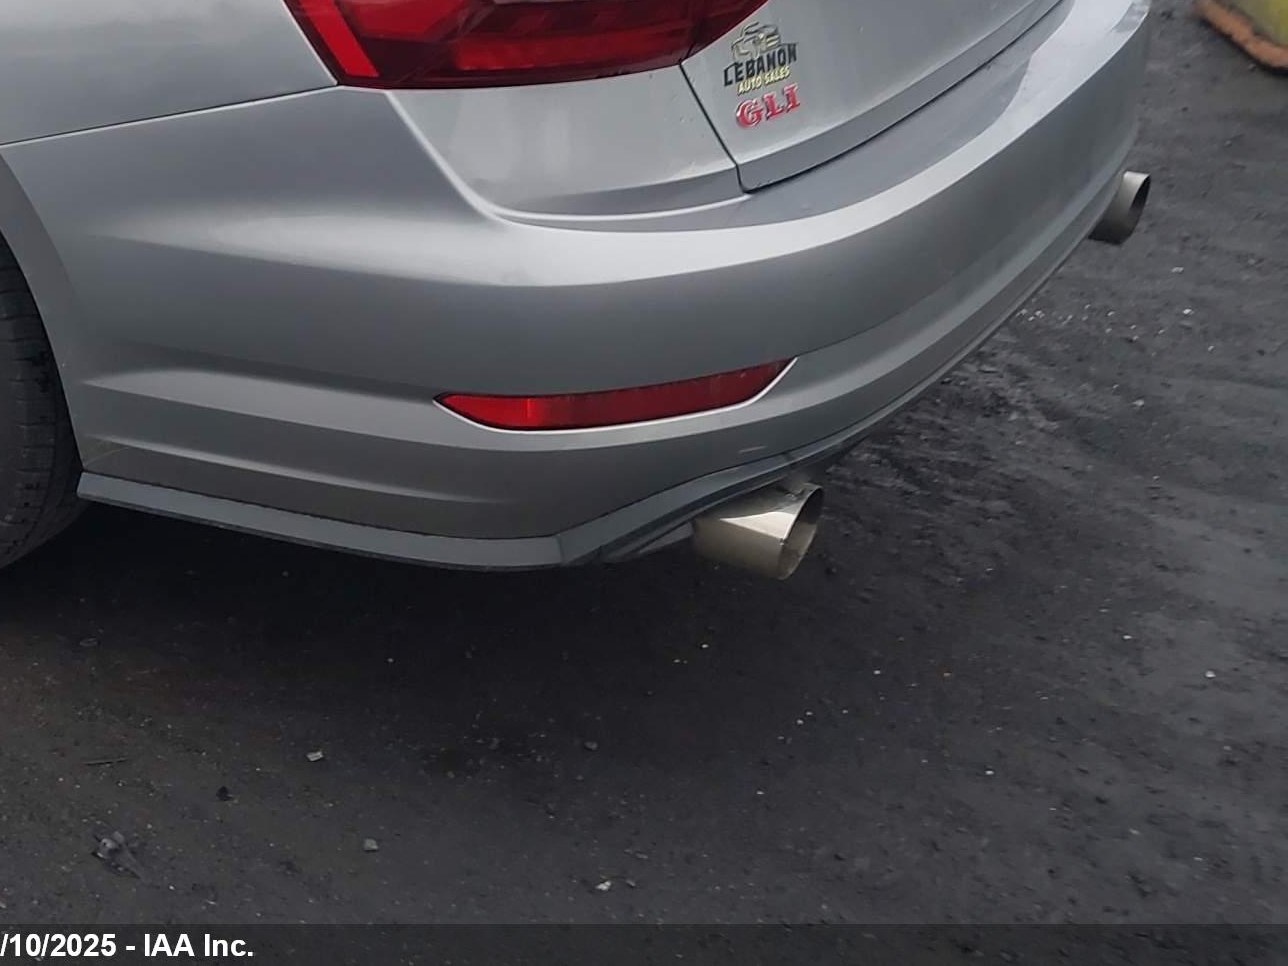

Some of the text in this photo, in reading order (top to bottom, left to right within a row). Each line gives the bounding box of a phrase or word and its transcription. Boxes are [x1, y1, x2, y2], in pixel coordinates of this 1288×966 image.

[723, 42, 798, 87] LEBANON
[737, 65, 791, 96] AUTO SALES
[736, 83, 800, 128] GLI
